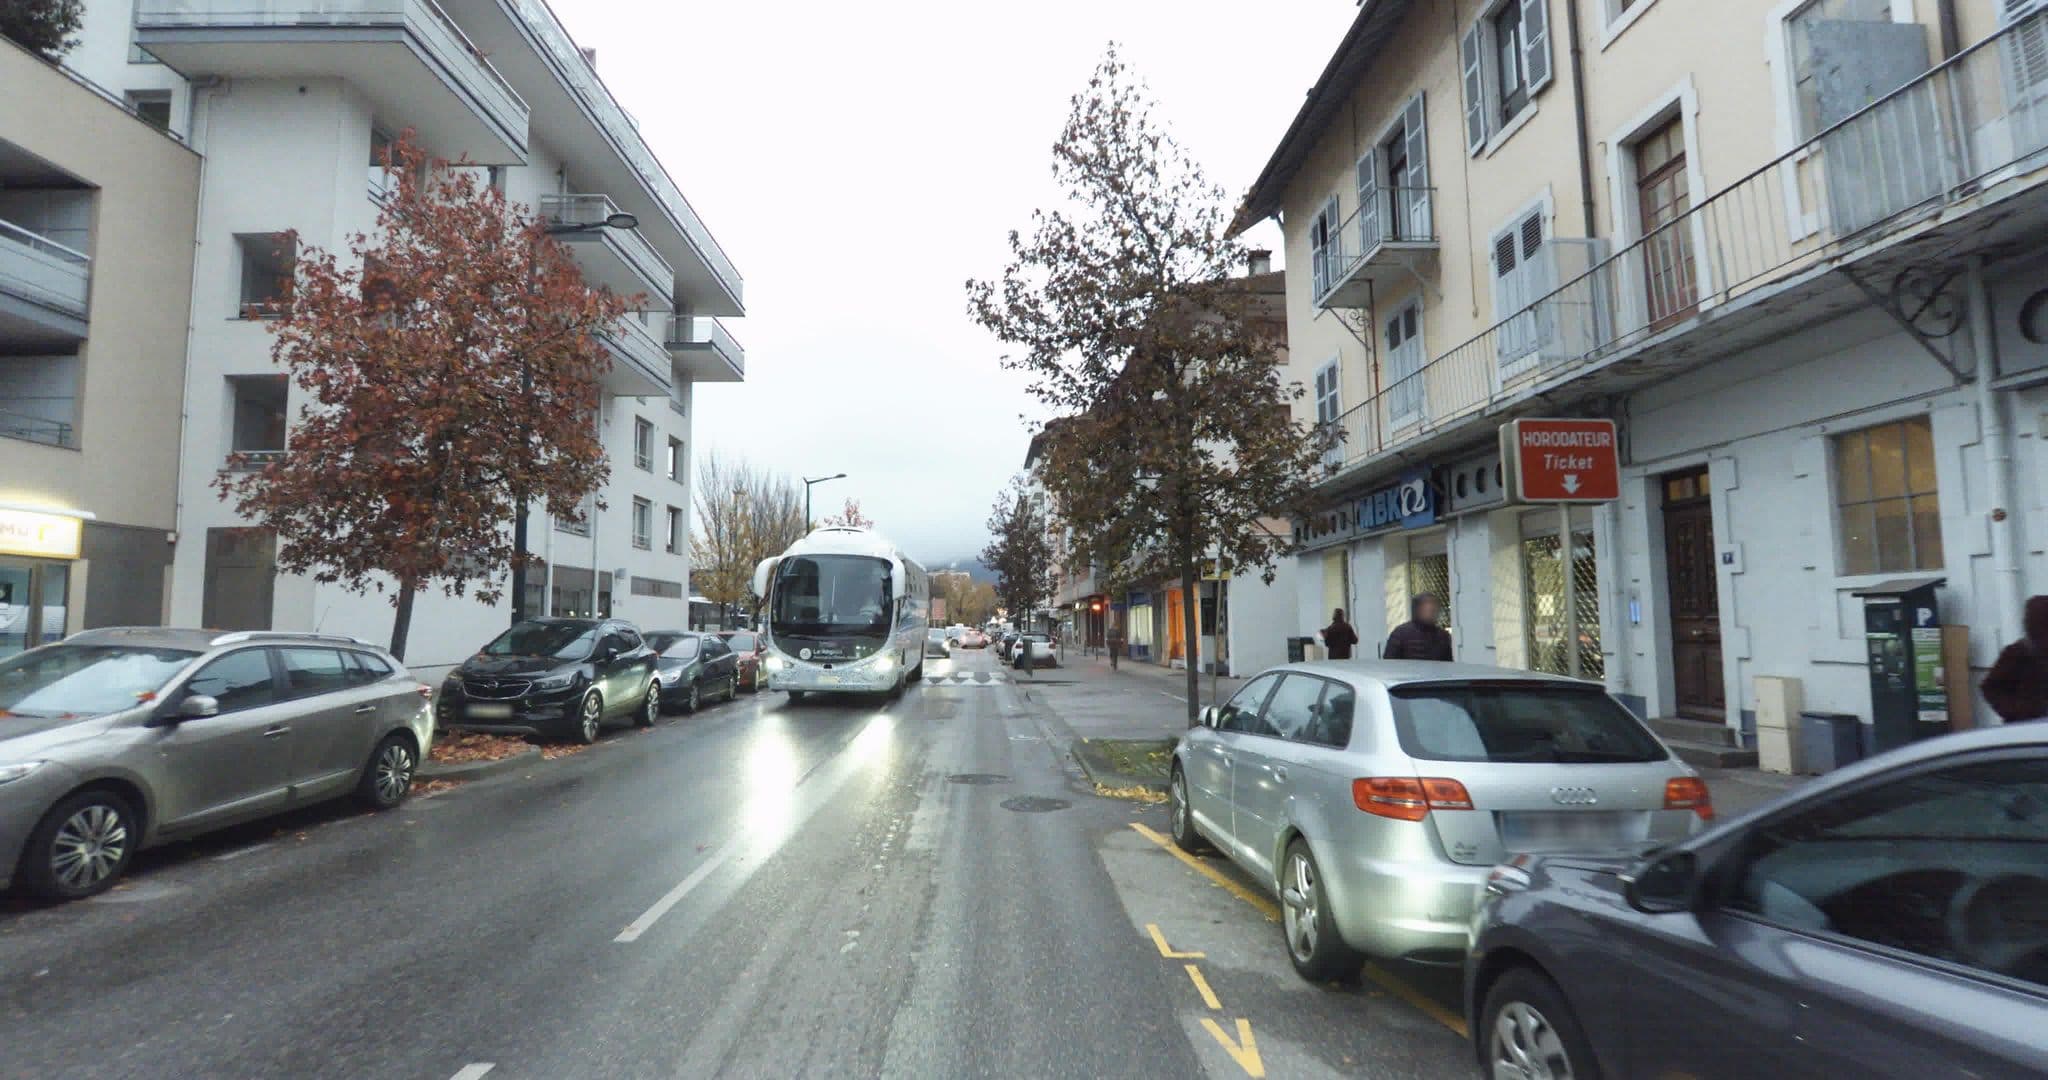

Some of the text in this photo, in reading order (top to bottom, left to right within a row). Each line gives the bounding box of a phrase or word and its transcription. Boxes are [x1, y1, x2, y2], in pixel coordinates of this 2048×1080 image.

[1522, 431, 1611, 448] HORODATEUR
[1543, 453, 1594, 470] Ticket
[1359, 486, 1402, 529] MBK
[1916, 607, 1933, 627] P
